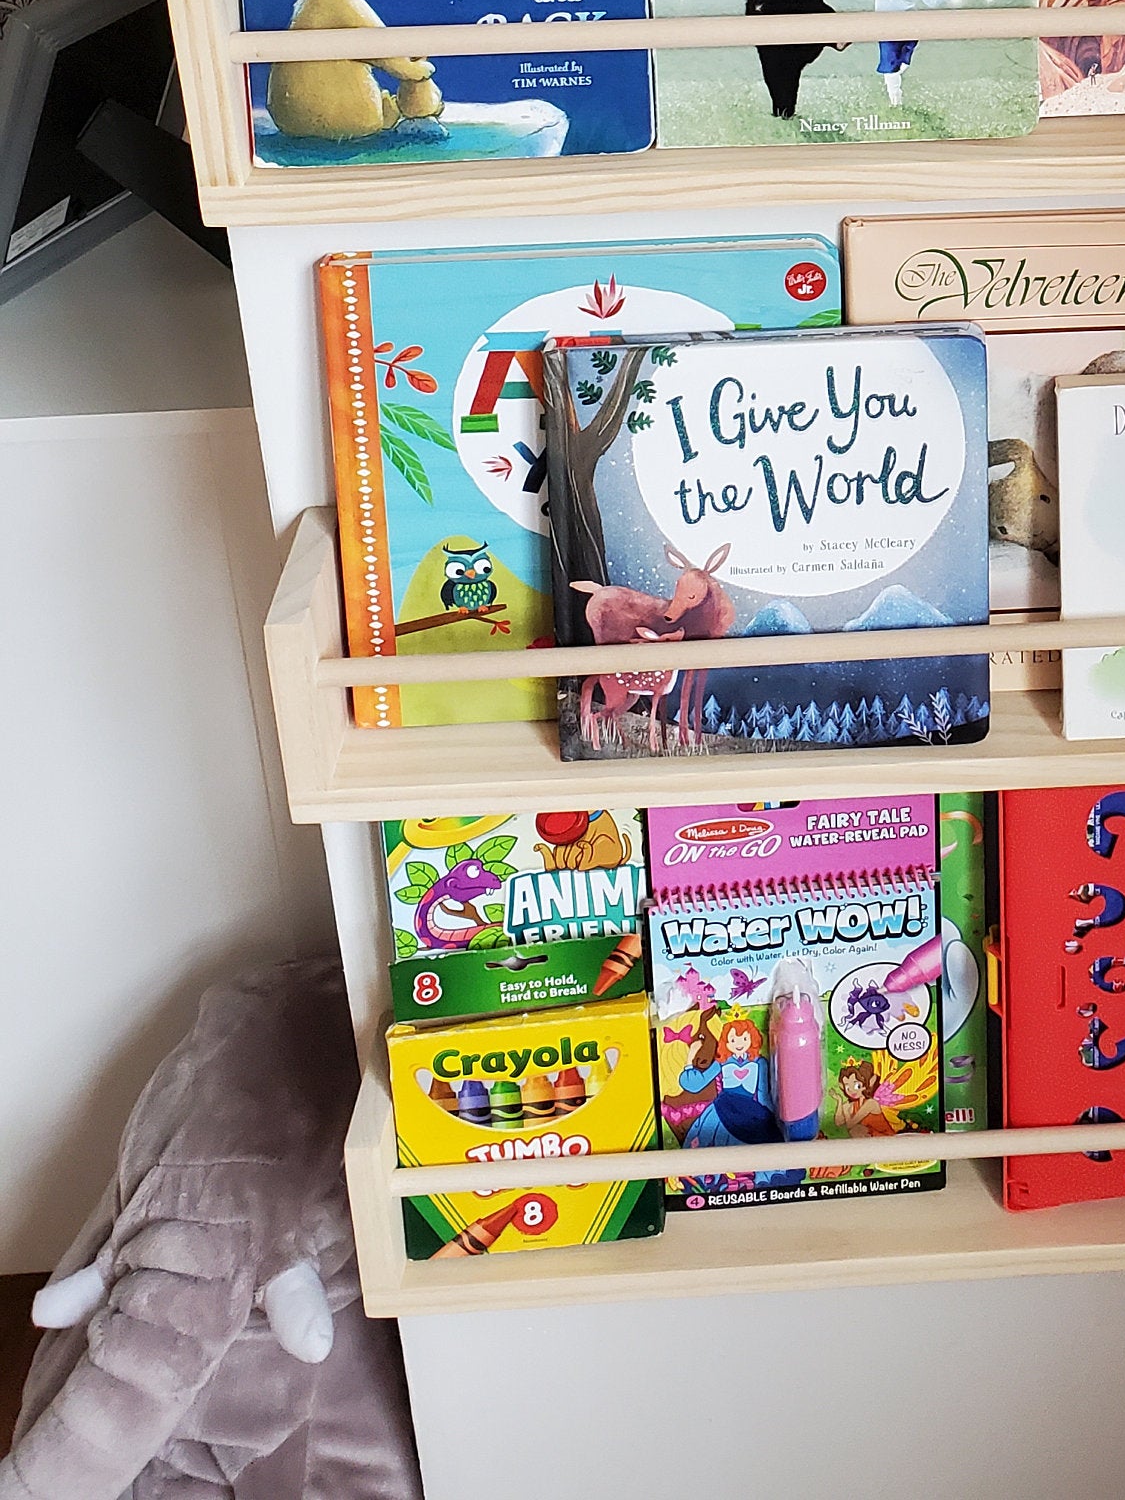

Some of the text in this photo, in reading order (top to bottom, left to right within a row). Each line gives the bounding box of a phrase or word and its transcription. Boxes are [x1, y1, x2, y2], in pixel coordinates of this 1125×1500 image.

[519, 62, 583, 76] Illustrated by
[512, 75, 592, 88] TIM WARNES
[800, 116, 912, 137] Nancy Tillman
[666, 364, 918, 464] I Give You
[674, 442, 950, 534] the World
[802, 536, 916, 553] by Stacey McCleary
[729, 556, 884, 576] Illustrated by Carmen Saldaña
[807, 807, 911, 831] FAIRY TALE
[790, 824, 928, 848] WATER-REVEAL PAD
[664, 834, 782, 866] ON the GO
[662, 895, 929, 958] Water WOW!
[710, 944, 878, 966] Color with Water, Let Dry, Color Again!
[414, 972, 442, 1004] 8
[500, 974, 578, 993] Easy to Hold,
[501, 984, 588, 1004] Hard to Break!
[894, 1041, 926, 1052] MESS!
[901, 1032, 918, 1041] NO
[432, 1037, 600, 1078] Crayola
[522, 1202, 543, 1226] 8
